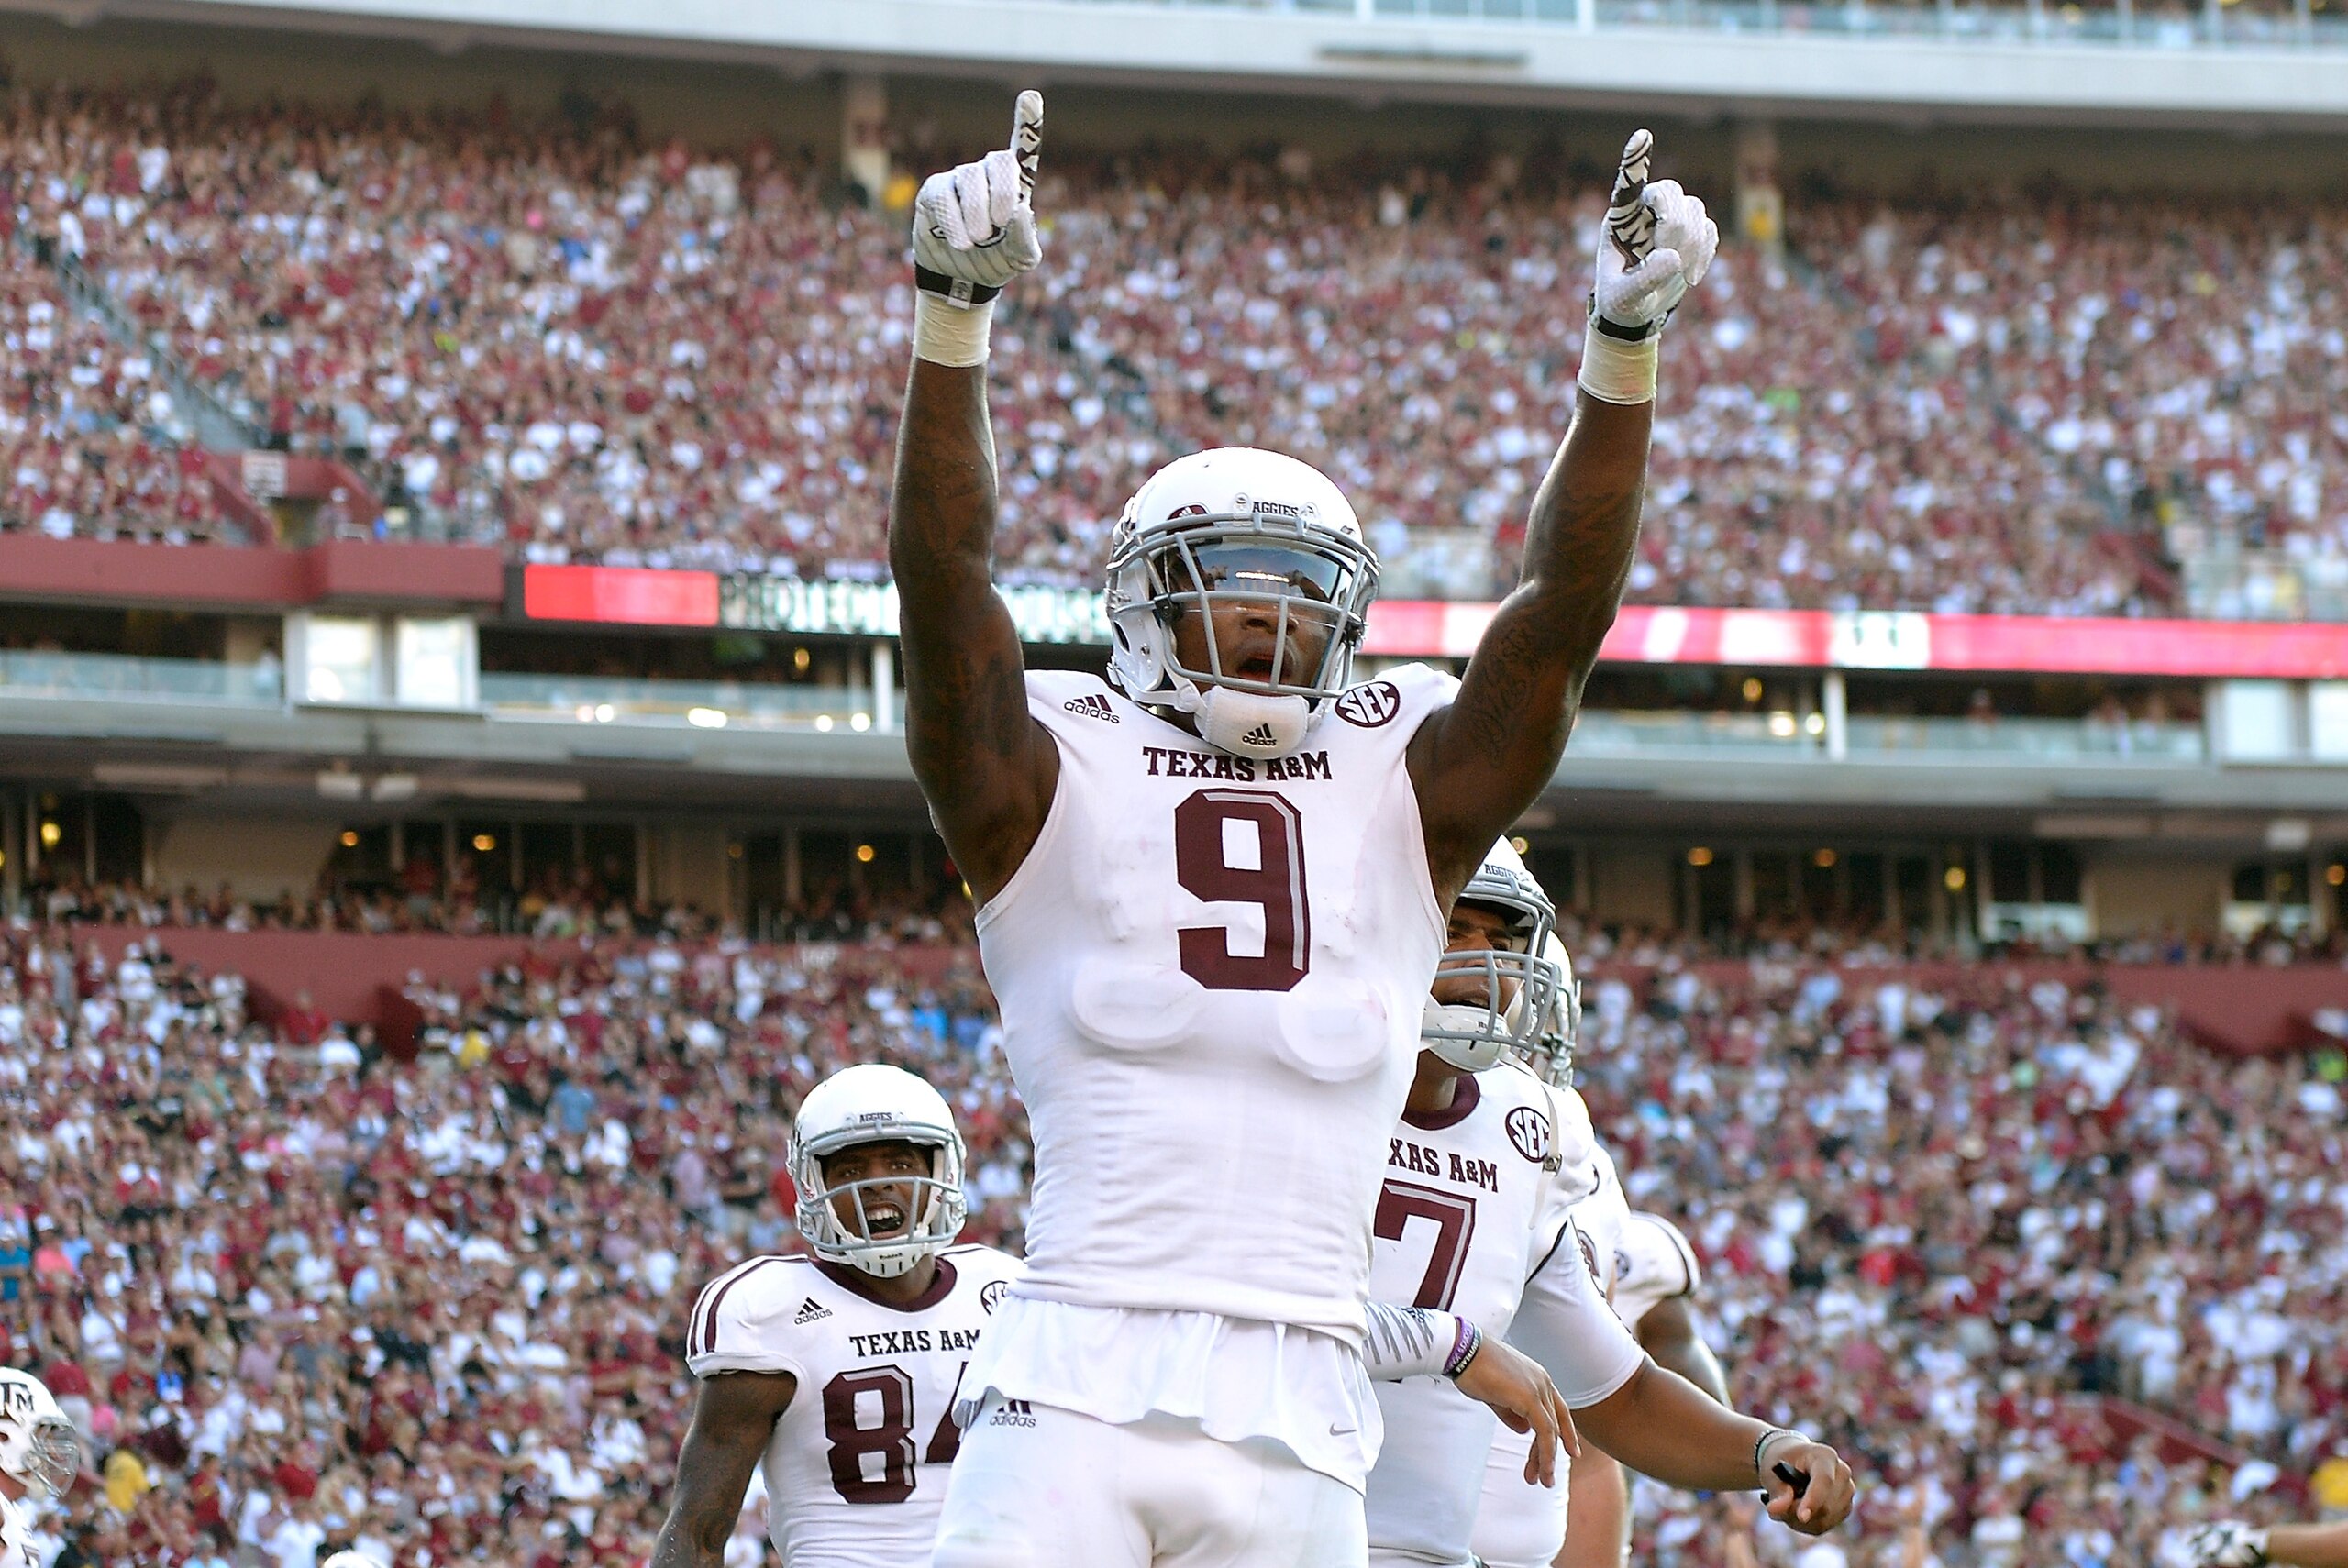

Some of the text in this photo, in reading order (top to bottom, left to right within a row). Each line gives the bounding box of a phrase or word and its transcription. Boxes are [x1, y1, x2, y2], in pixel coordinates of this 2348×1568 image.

[1251, 501, 1300, 518] AGGIES
[1064, 701, 1121, 724] adidas
[1338, 682, 1396, 724] SEC
[1241, 734, 1278, 746] adidas
[1142, 746, 1333, 782] TEXAS A&M
[1174, 787, 1311, 993] 9
[858, 1111, 892, 1123] AGGIES
[1507, 1107, 1550, 1161] SEC
[1388, 1137, 1500, 1194] XAS A&M
[1374, 1177, 1478, 1313] 7
[793, 1307, 834, 1326] adidas
[849, 1330, 932, 1358] TEXAS
[989, 1412, 1037, 1429] adidas
